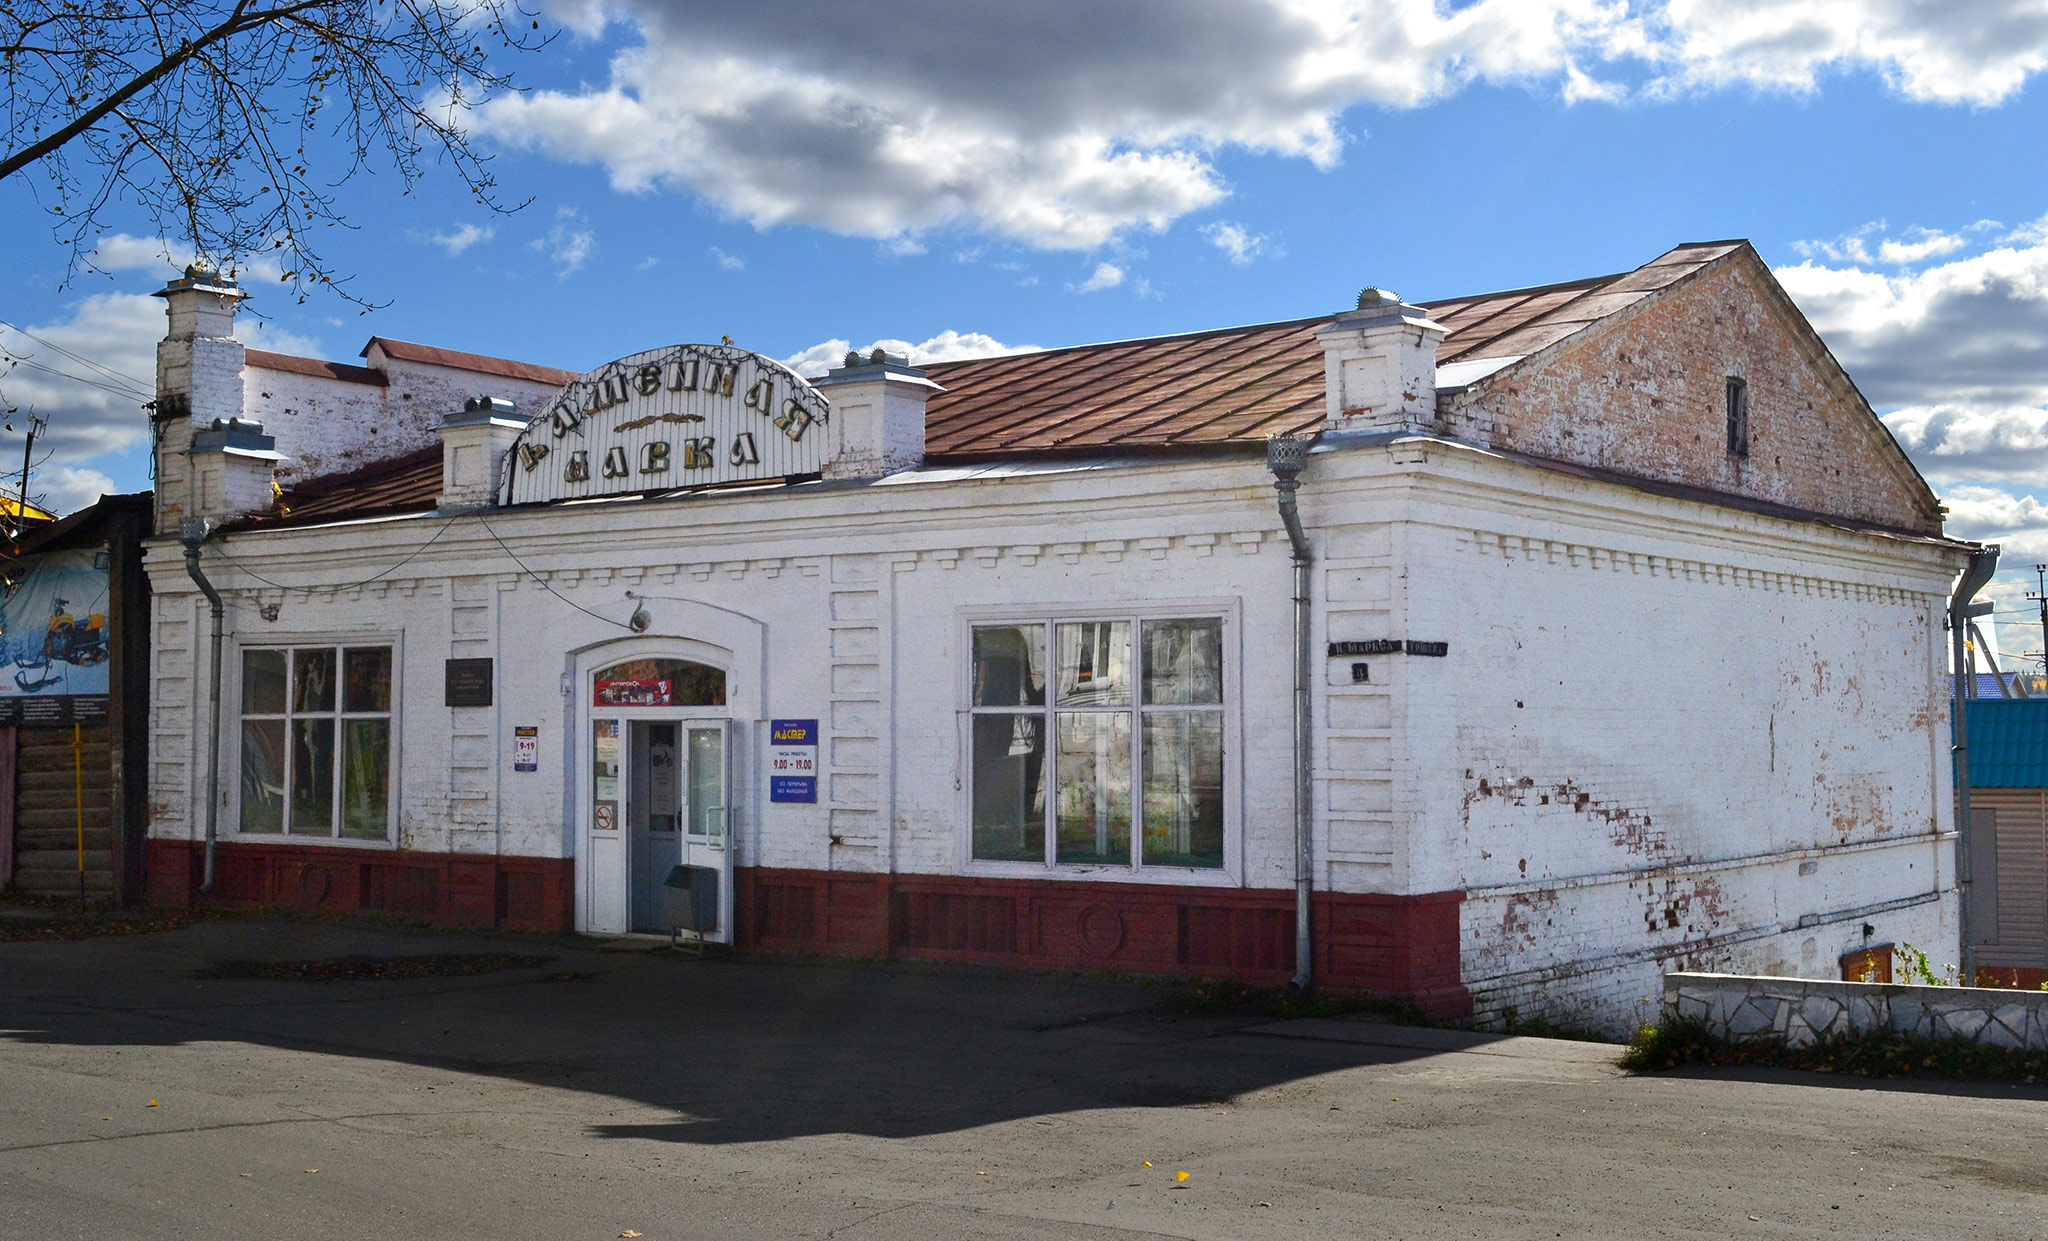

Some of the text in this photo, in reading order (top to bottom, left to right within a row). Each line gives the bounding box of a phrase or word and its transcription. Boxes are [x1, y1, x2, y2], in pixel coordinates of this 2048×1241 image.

[518, 359, 812, 472] КАМЕННАЯ
[563, 432, 760, 483] ЛАВКА
[773, 759, 788, 770] 9.00
[795, 759, 812, 770] 19.00
